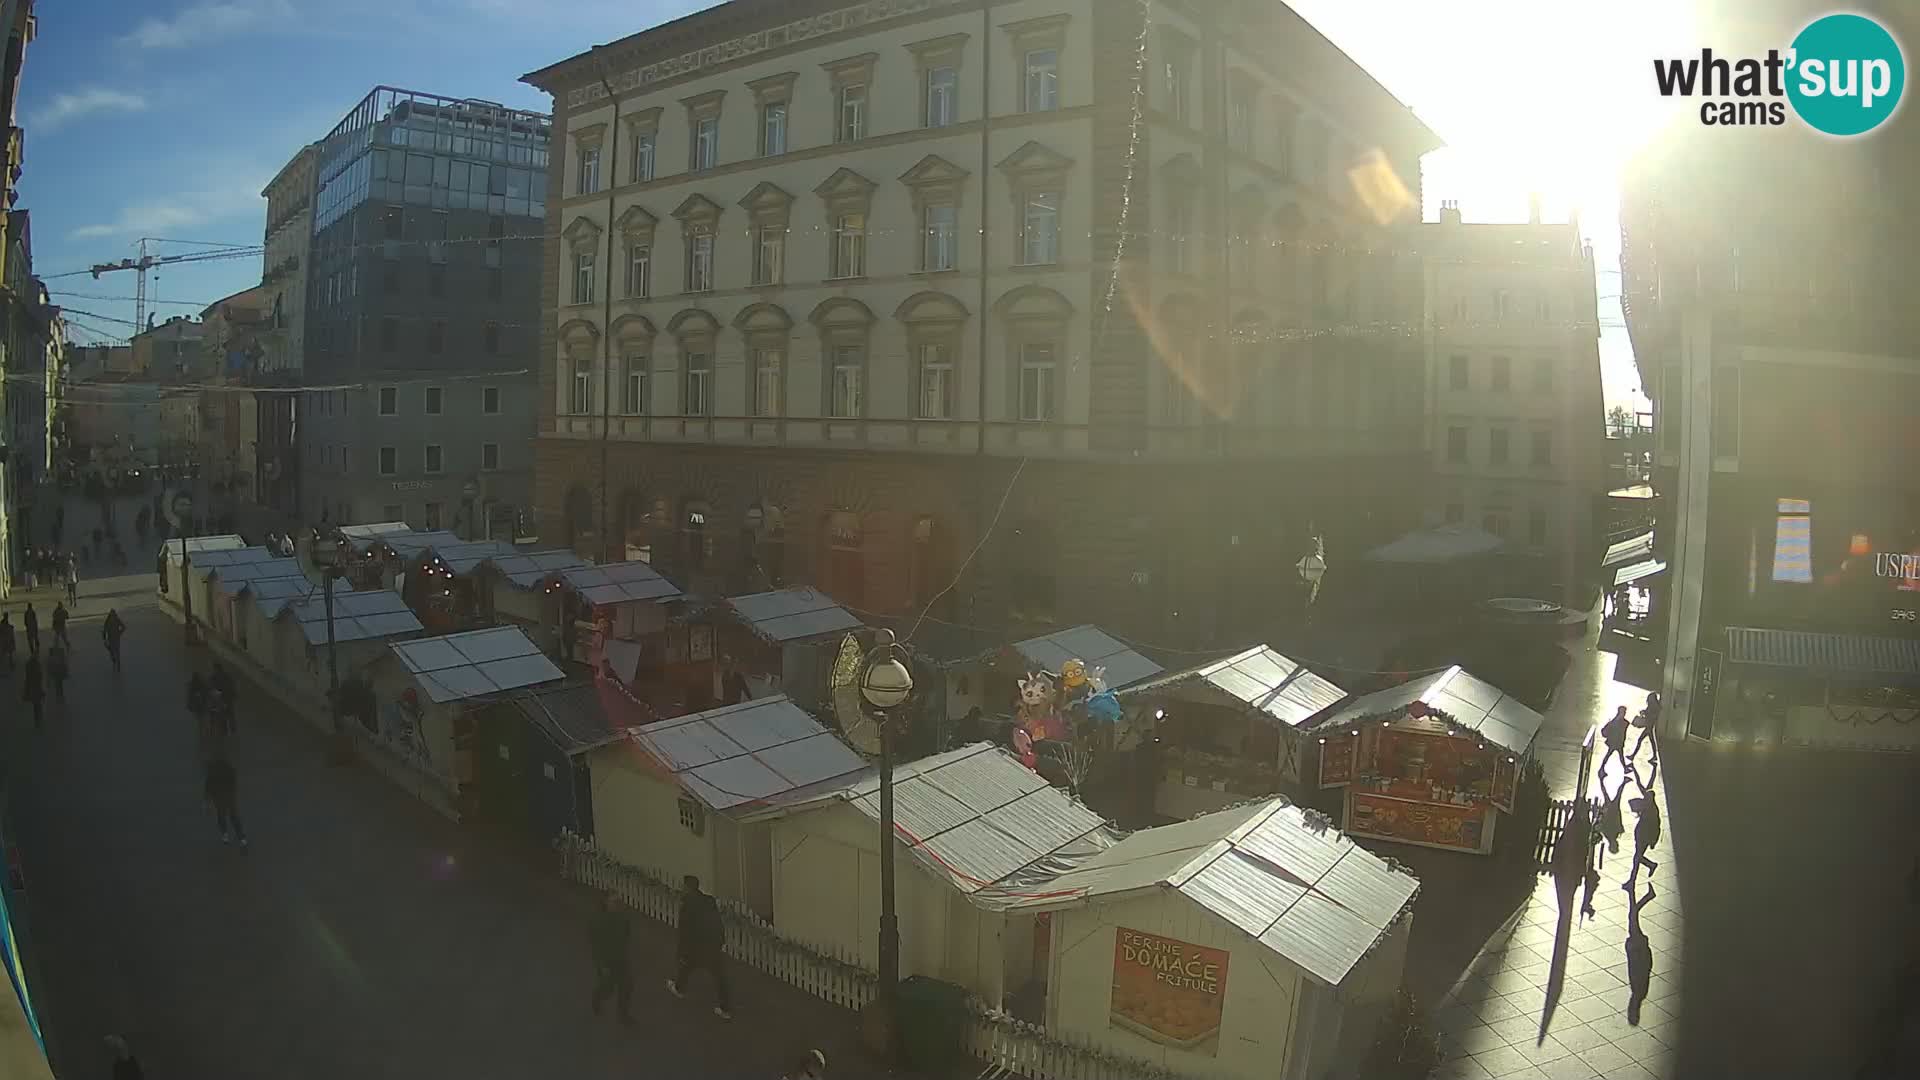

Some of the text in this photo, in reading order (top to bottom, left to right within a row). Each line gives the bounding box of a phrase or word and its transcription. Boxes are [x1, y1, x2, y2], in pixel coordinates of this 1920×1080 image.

[1123, 931, 1181, 956] PERINE
[1122, 944, 1219, 981] DOMAĆE
[1156, 972, 1217, 994] FRITULE
